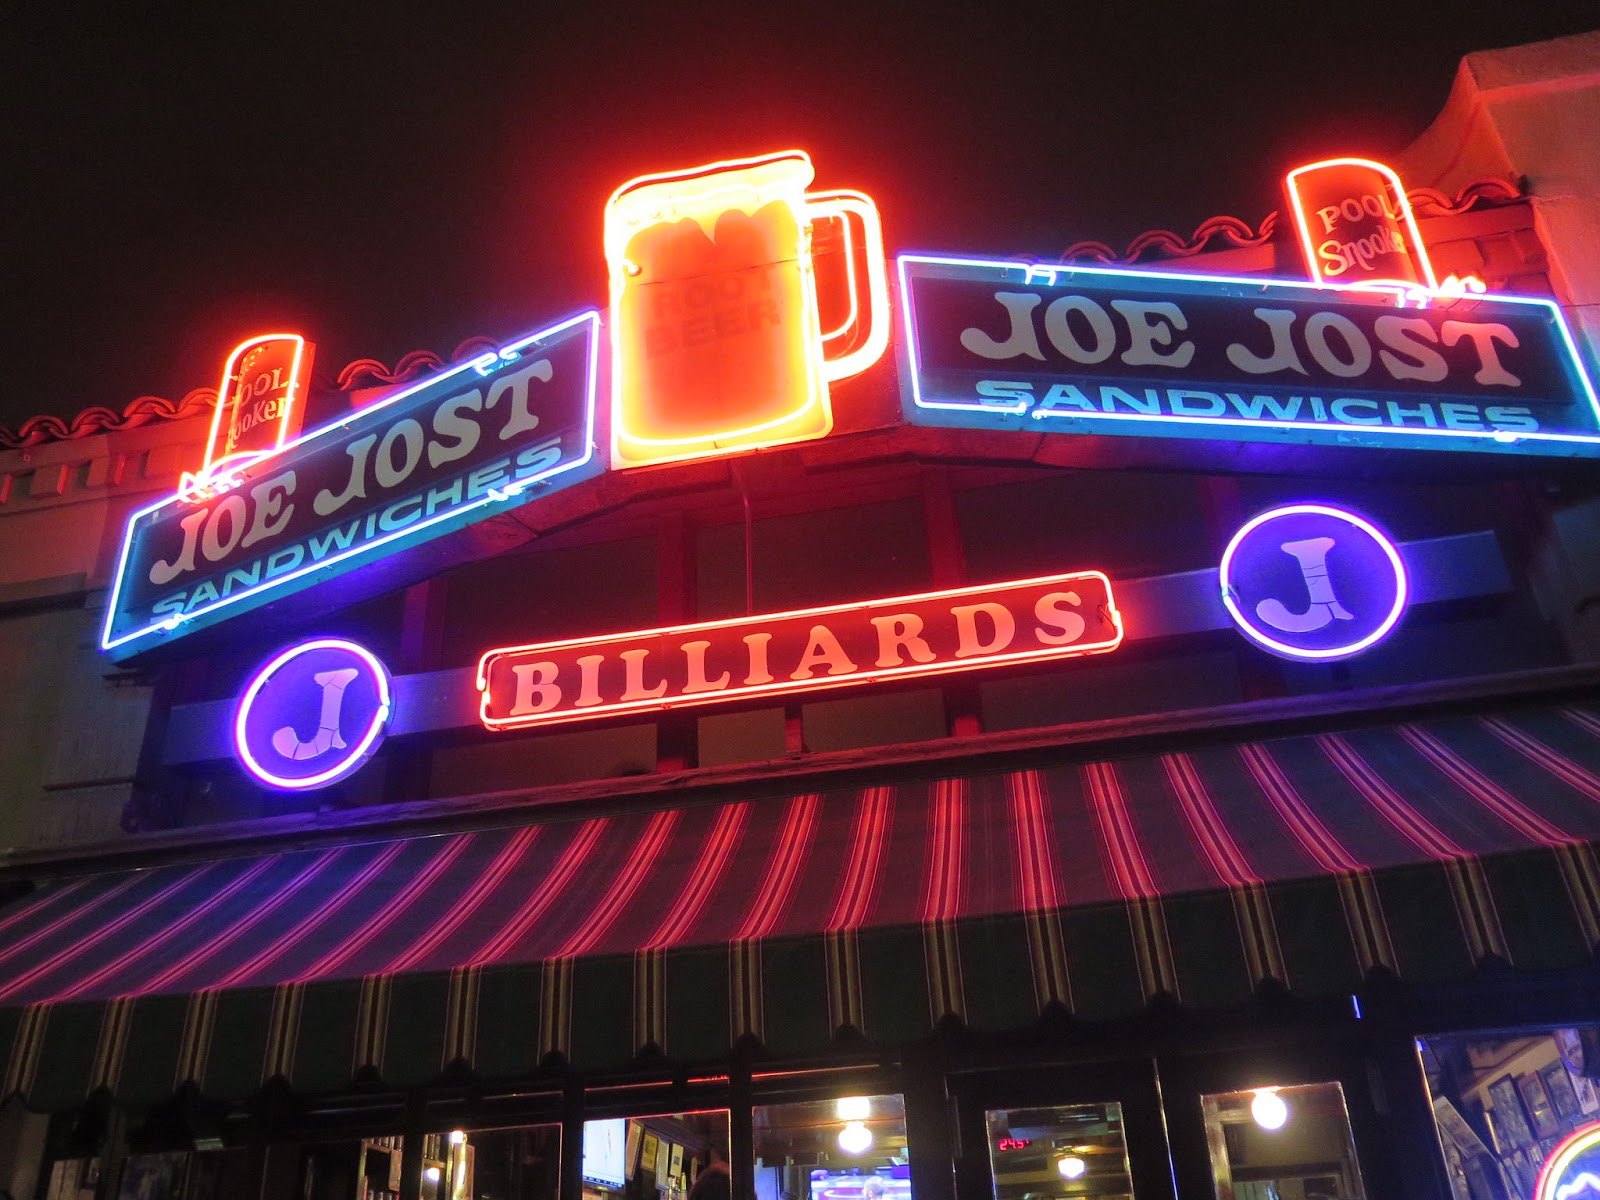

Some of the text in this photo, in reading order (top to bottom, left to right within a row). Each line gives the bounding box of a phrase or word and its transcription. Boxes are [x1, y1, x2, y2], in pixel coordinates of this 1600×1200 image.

[1317, 224, 1407, 276] Snooke
[240, 367, 289, 408] OOL
[960, 291, 1521, 388] JOE JOST
[974, 379, 1539, 432] SANDWICHES
[149, 359, 553, 585] JOE JOST
[149, 437, 563, 621] SANDWICHES
[1256, 537, 1354, 633] J
[509, 591, 1087, 716] BILLIARDS
[272, 668, 359, 761] J
